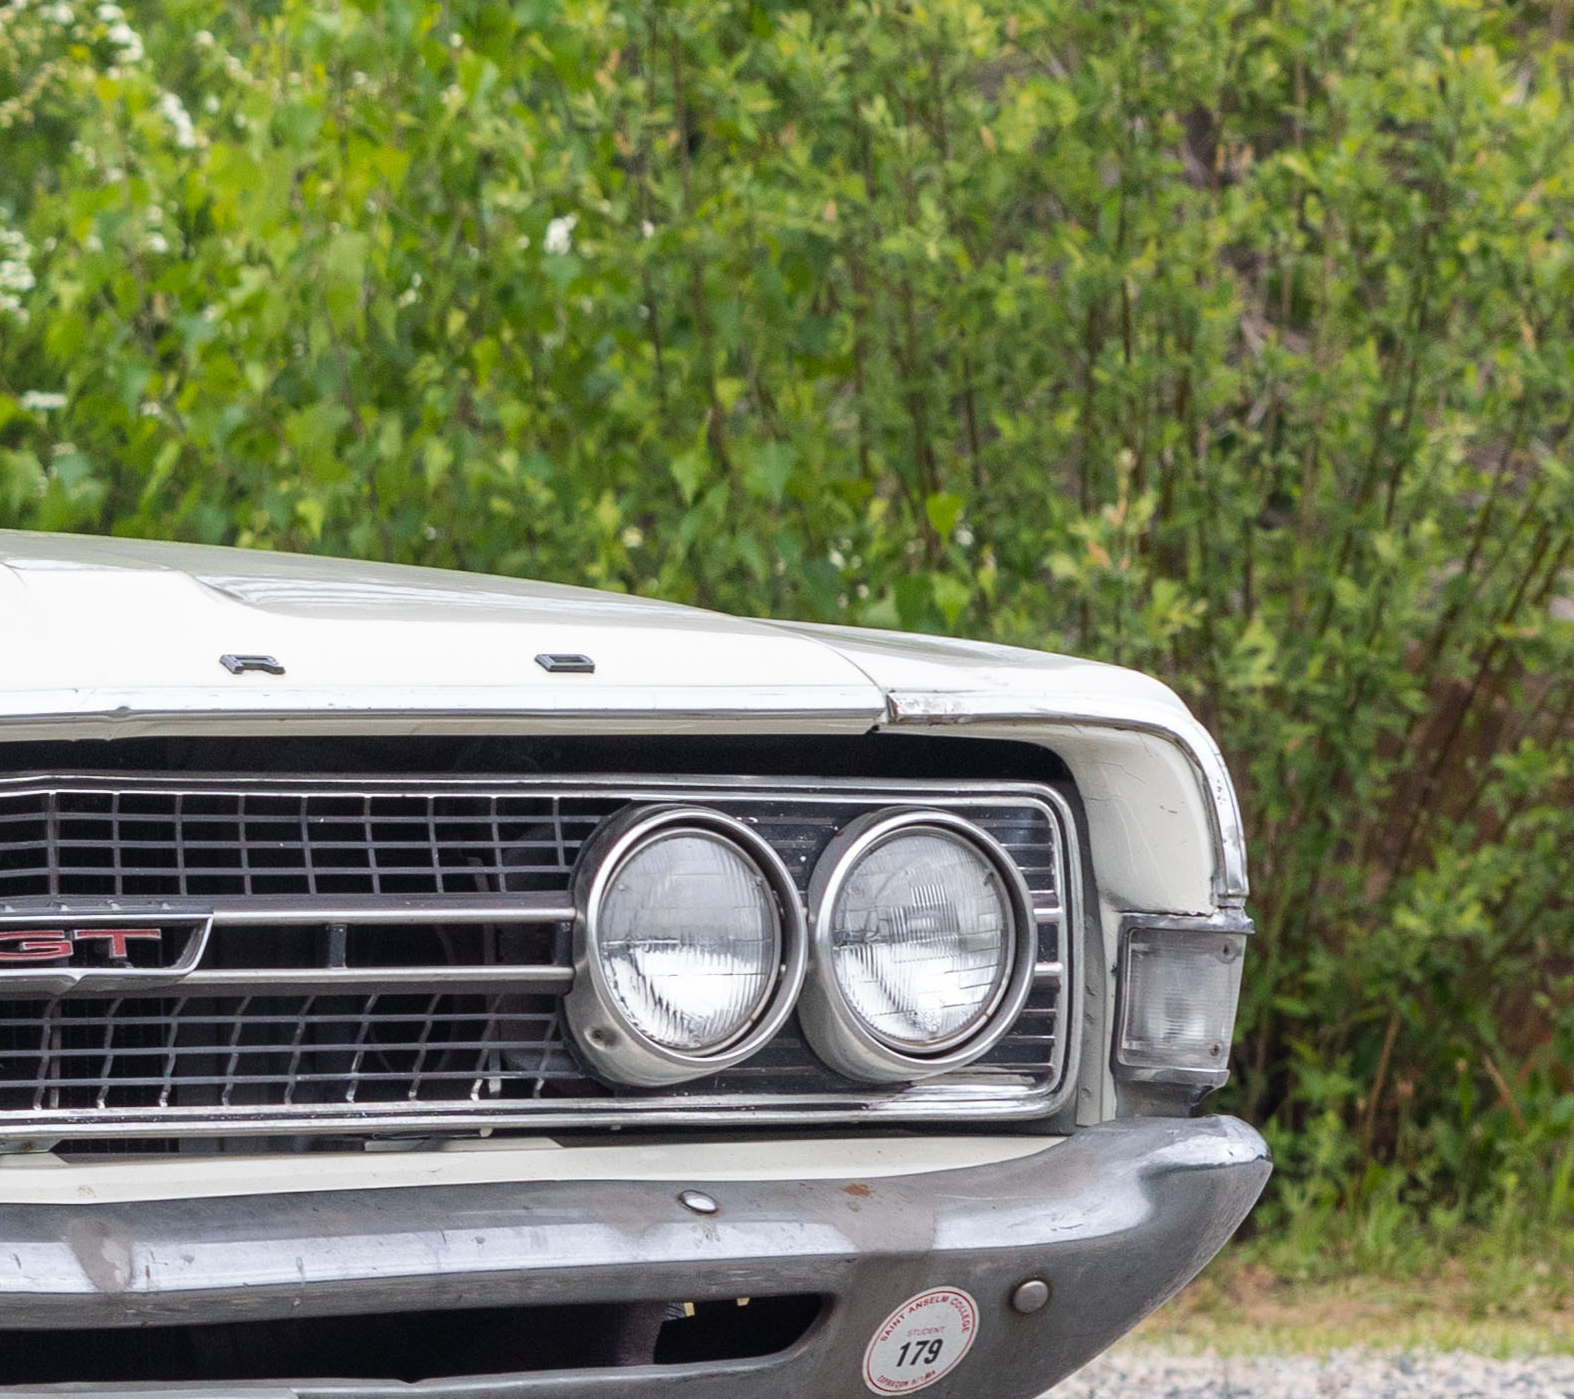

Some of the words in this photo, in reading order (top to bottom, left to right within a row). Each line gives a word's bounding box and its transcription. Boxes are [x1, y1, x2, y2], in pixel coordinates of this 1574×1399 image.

[880, 1314, 906, 1342] SAINT
[907, 1295, 950, 1314] ANSELM
[949, 1297, 971, 1334] COLLEGE
[895, 1338, 944, 1367] 179
